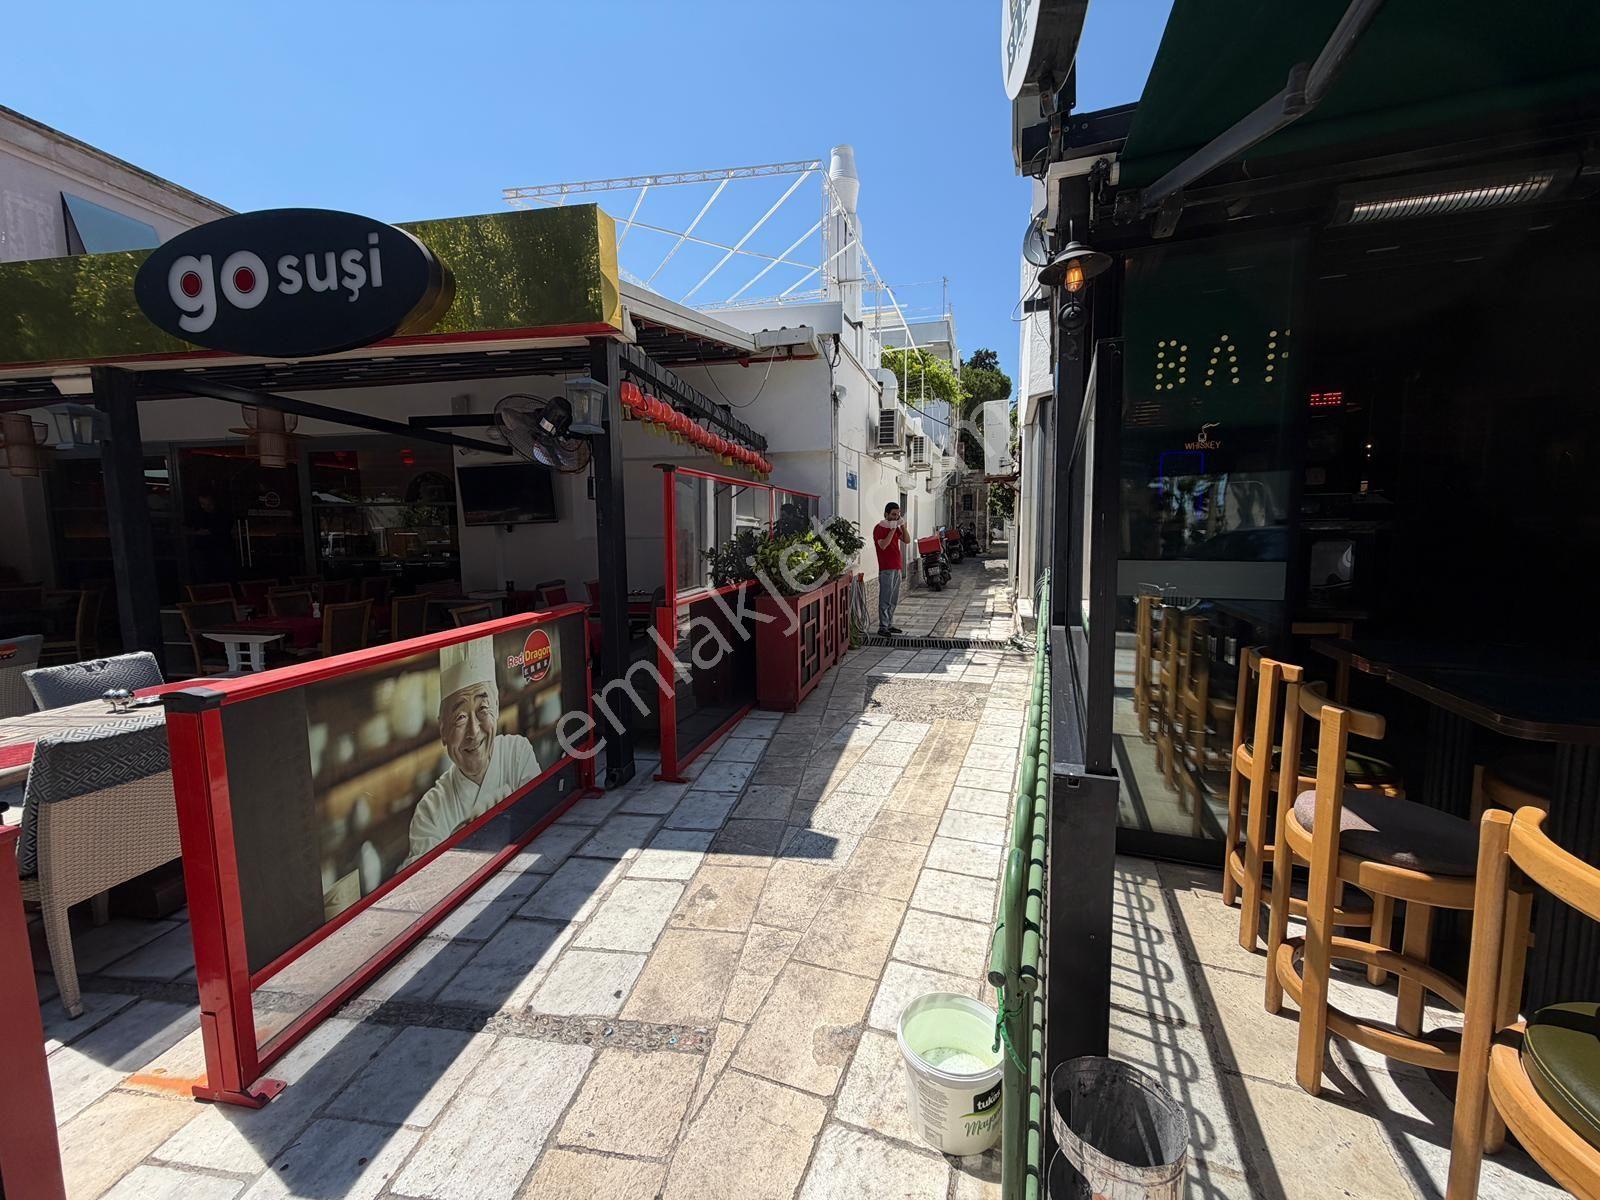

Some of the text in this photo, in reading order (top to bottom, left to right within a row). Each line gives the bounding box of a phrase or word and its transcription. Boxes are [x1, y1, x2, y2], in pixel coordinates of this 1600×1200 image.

[167, 232, 383, 333] go suşi
[1184, 440, 1221, 450] WHISKEY
[507, 651, 525, 669] Red
[524, 645, 551, 661] Dragon
